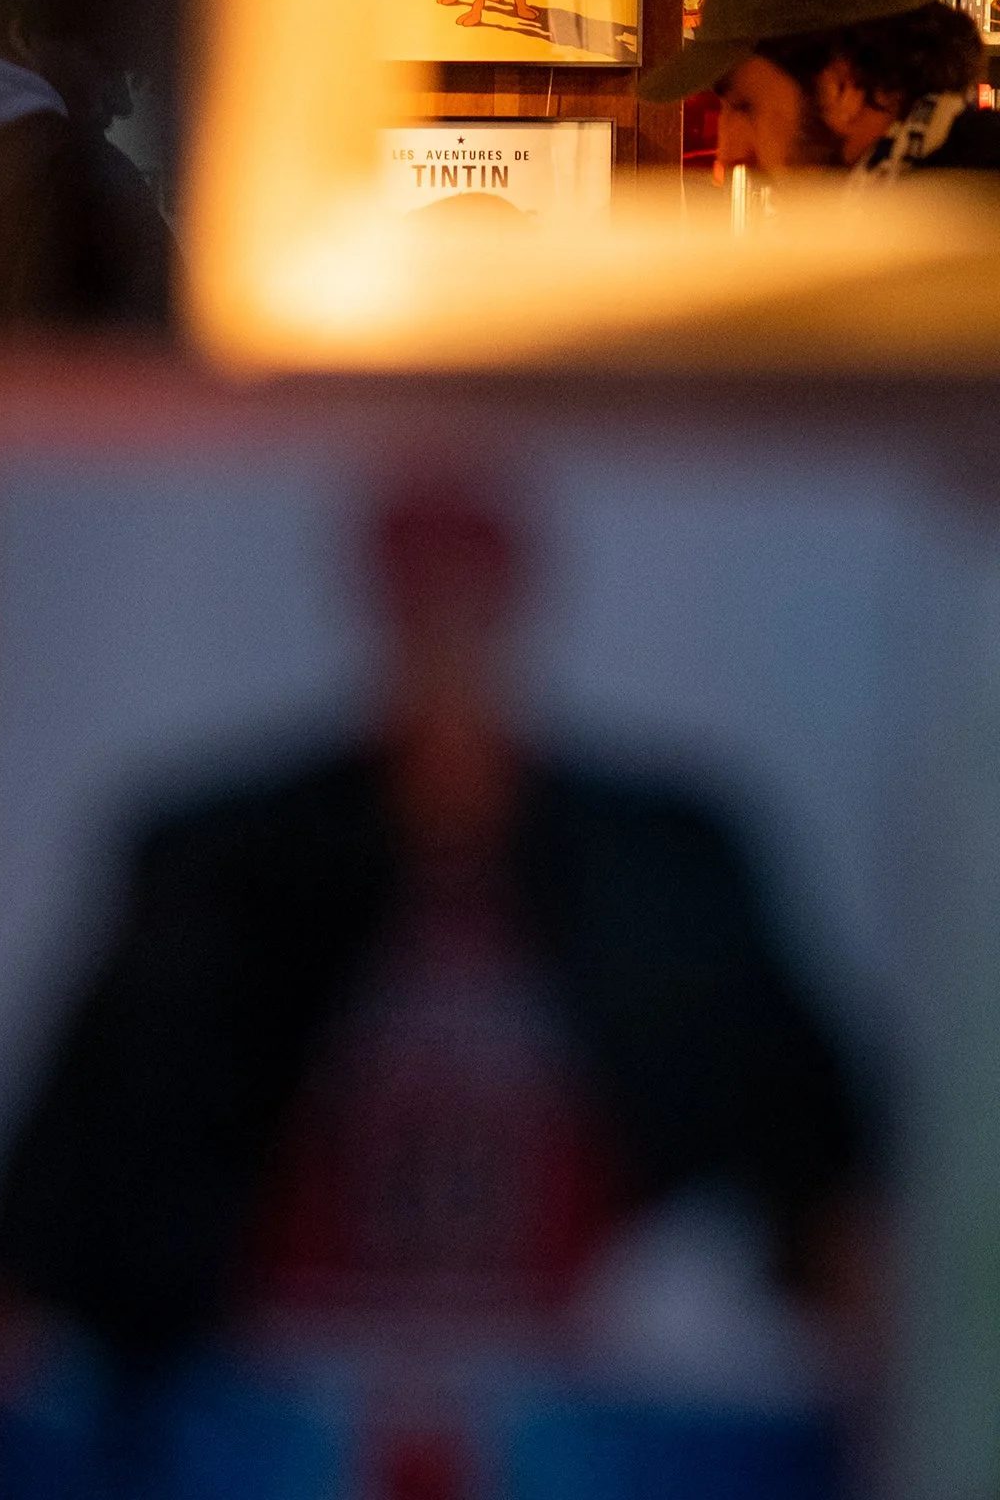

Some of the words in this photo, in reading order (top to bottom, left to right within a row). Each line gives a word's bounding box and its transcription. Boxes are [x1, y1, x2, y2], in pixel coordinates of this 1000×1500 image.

[392, 149, 415, 160] LES
[426, 150, 502, 161] AVENTURES
[514, 150, 530, 161] DE
[411, 164, 509, 188] TINTIN
